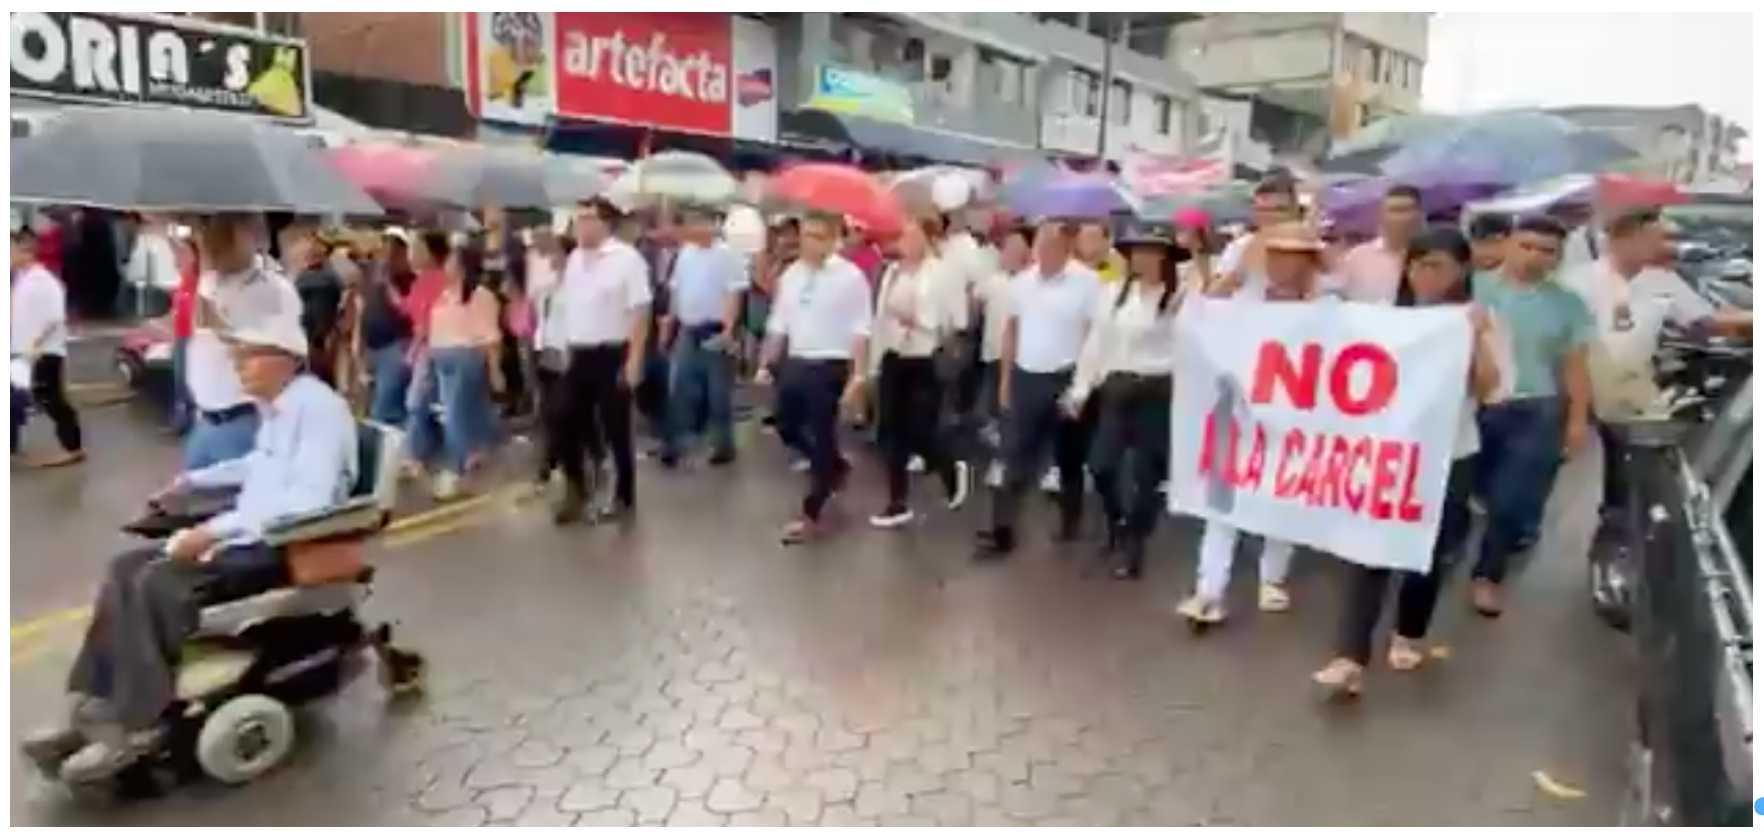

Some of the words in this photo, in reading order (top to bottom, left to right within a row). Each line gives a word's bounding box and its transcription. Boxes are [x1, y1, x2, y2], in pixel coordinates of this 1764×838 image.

[565, 29, 726, 103] artefacta
[1251, 339, 1398, 415] NO
[1222, 413, 1266, 492] LA
[1273, 427, 1423, 521] CARCEL
